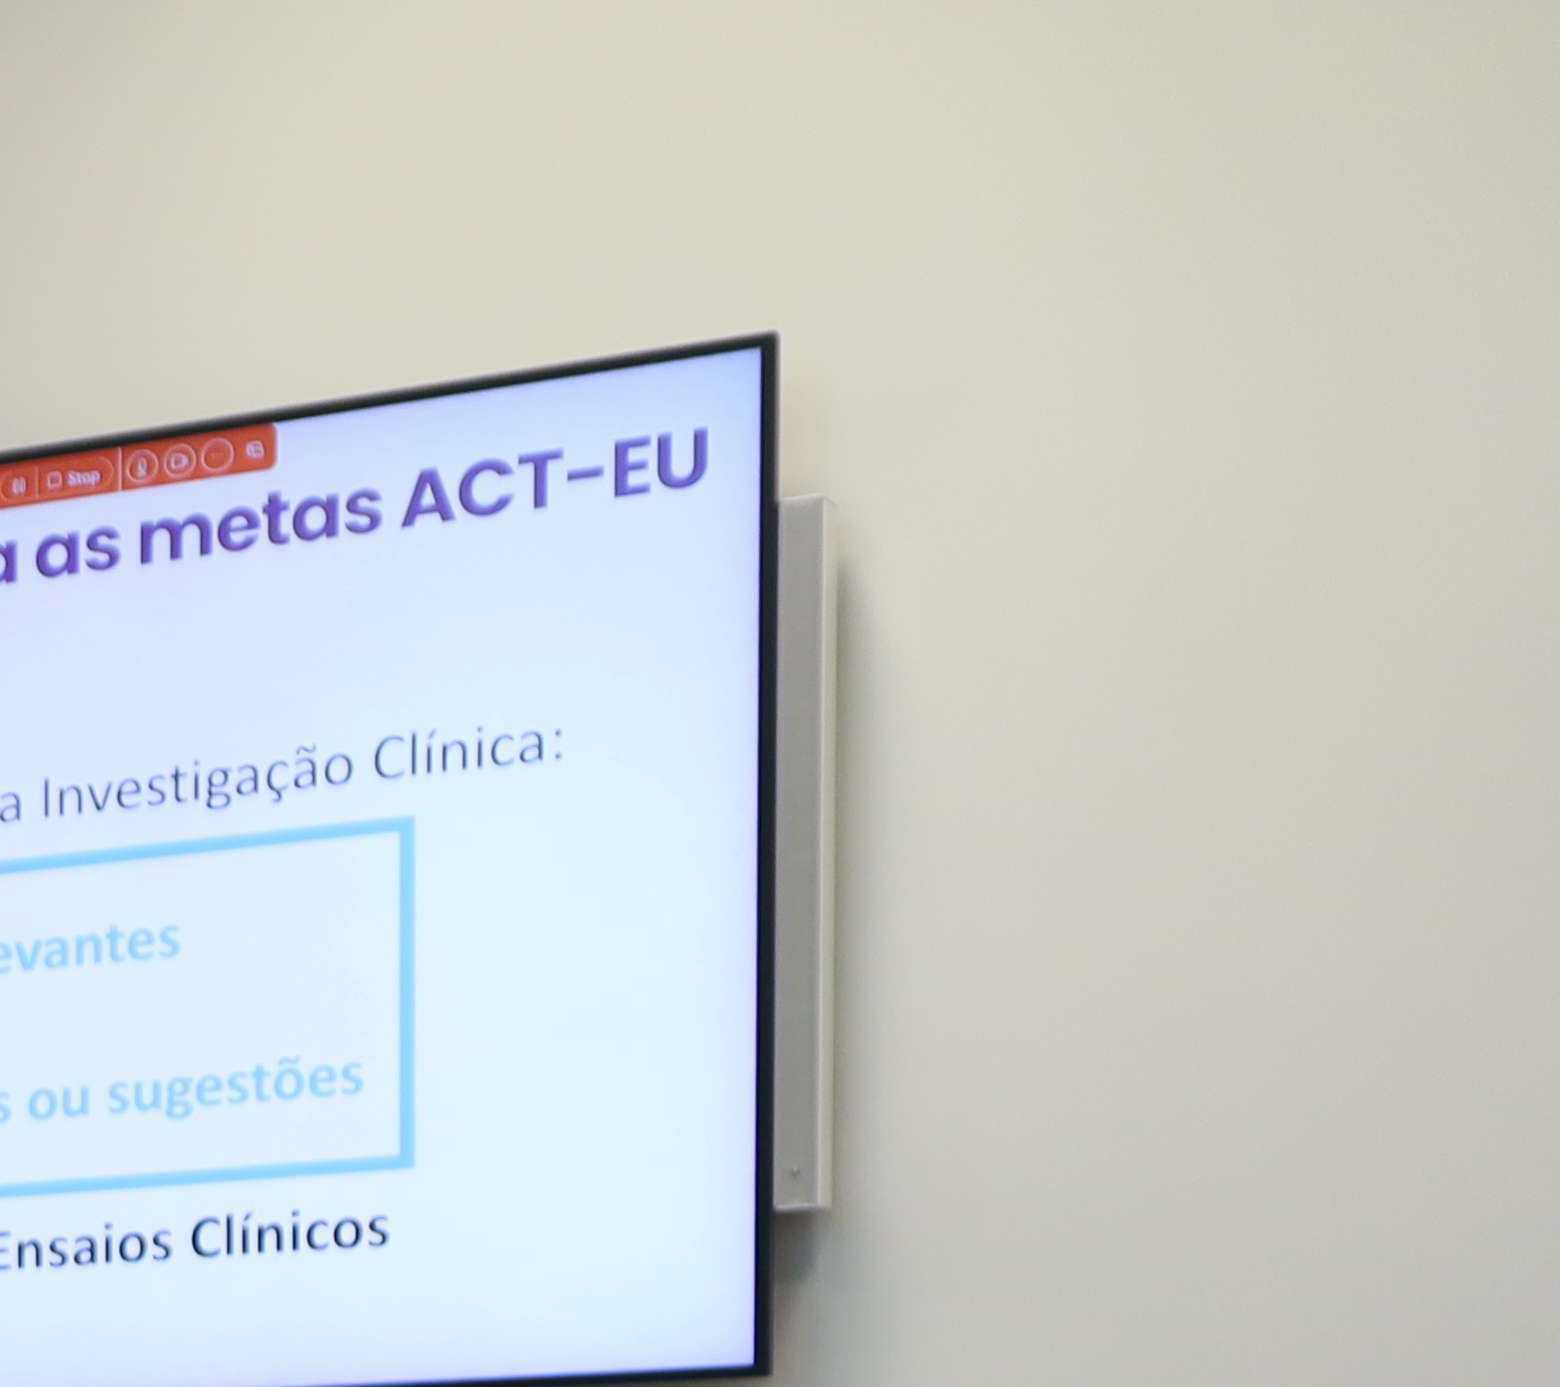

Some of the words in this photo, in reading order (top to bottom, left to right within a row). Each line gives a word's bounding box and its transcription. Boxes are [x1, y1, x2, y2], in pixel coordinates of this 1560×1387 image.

[35, 526, 121, 579] as
[140, 488, 383, 567] metas
[400, 427, 708, 530] ACT-EU
[68, 466, 101, 487] Stop
[44, 753, 354, 818] Investigação
[374, 726, 562, 780] Clínica:
[27, 1087, 89, 1120] ou
[108, 1056, 364, 1120] sugestões
[191, 1209, 390, 1260] Clínicos
